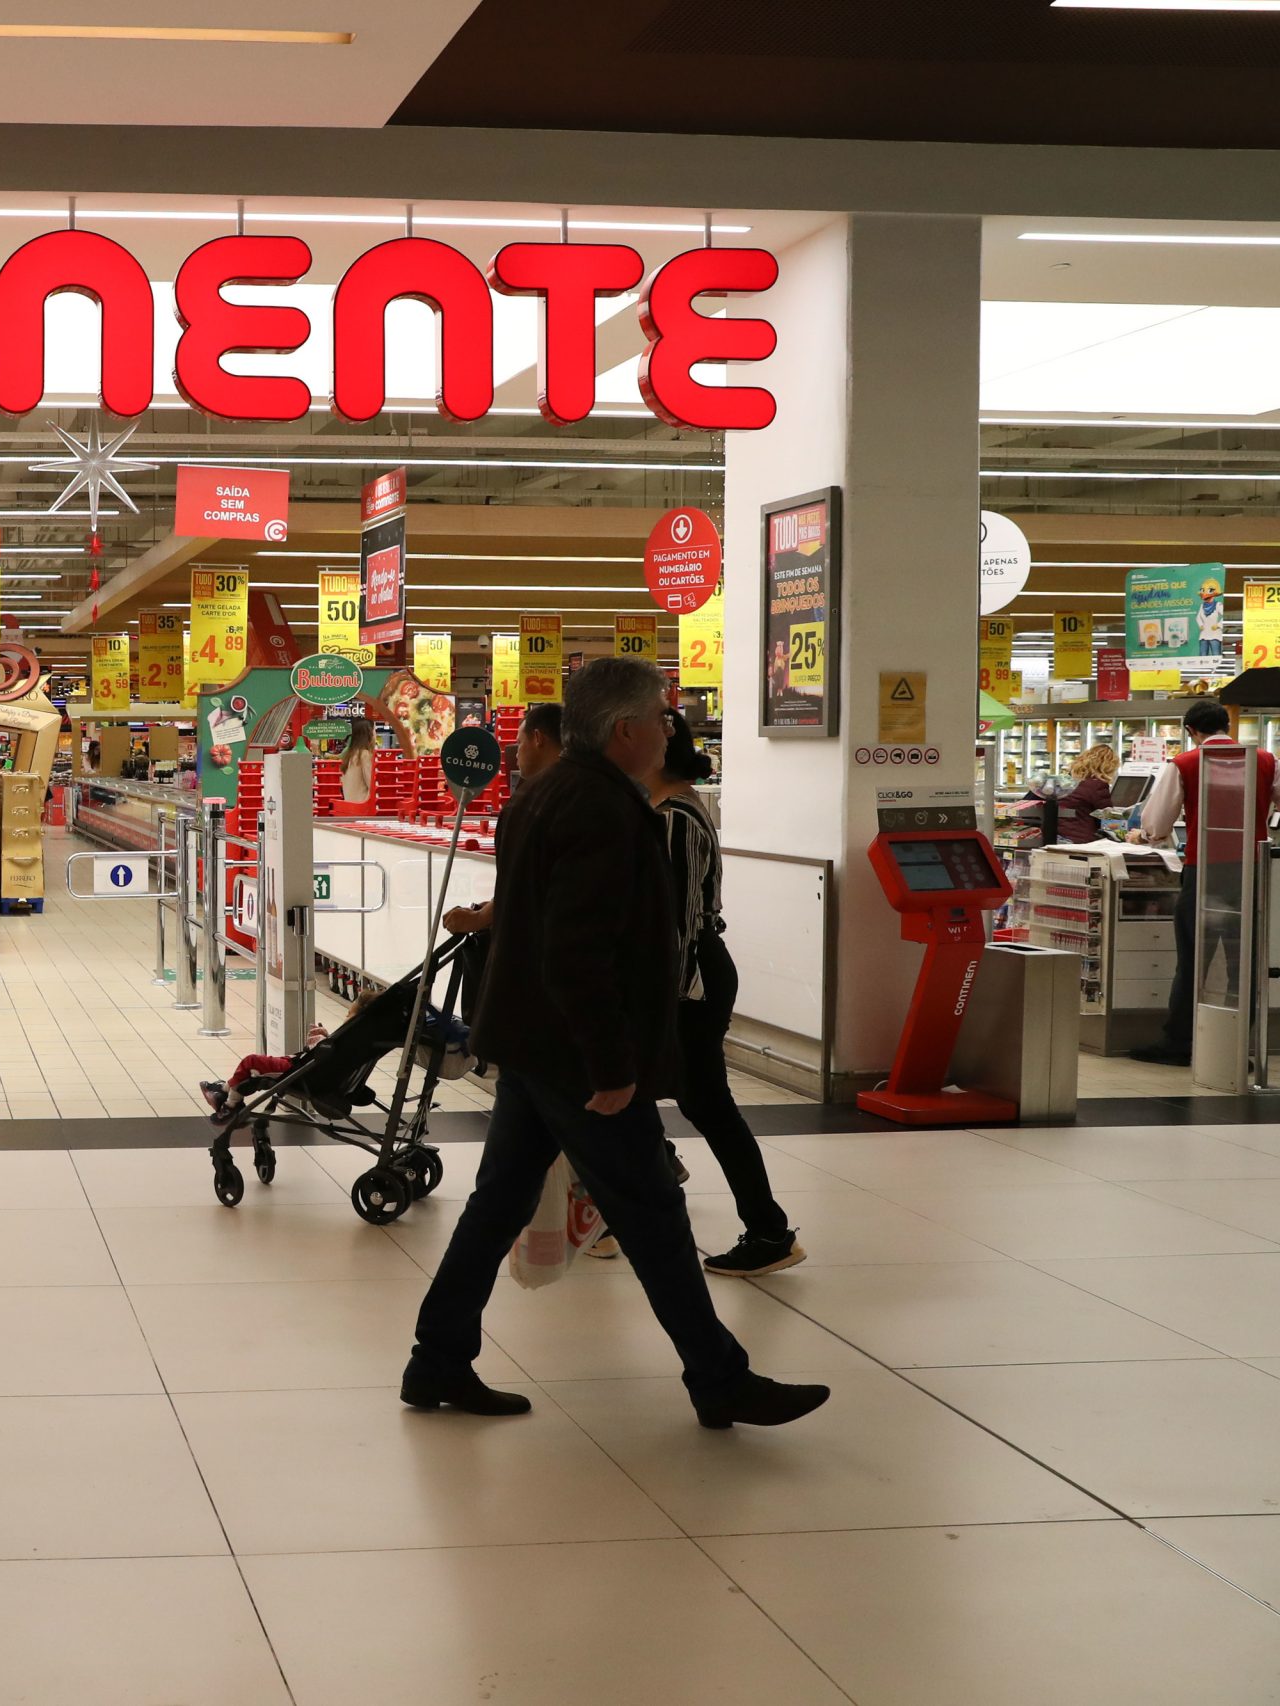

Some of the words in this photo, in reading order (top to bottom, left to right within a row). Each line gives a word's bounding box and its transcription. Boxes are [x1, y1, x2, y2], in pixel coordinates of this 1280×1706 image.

[216, 485, 250, 497] SAÍDA
[220, 499, 245, 509] SEM
[204, 511, 260, 523] COMPRAS
[774, 514, 798, 551] TUDO
[653, 551, 698, 563] PAGAMENTO
[698, 550, 710, 559] EM
[983, 557, 1018, 566] APENAS
[659, 561, 702, 574] NUMERÁRIO
[774, 570, 785, 580] ESTE
[786, 569, 794, 578] FIM
[795, 568, 801, 576] DE
[802, 565, 822, 575] SEMANA
[981, 567, 1004, 576] TÕES
[195, 573, 212, 585] TUDO
[215, 575, 245, 592] 30%
[324, 575, 347, 592] TUDO
[658, 577, 670, 586] OU
[671, 574, 705, 585] CARTÕES
[776, 578, 806, 597] TODOS
[806, 577, 819, 592] OS
[1131, 581, 1169, 592] PRESENTES
[1170, 581, 1187, 589] QUE
[770, 592, 825, 614] BRINQUEDOS
[327, 600, 359, 622] 50
[523, 617, 541, 631] TUDO
[527, 636, 554, 653] 10%
[621, 636, 651, 653] 30%
[791, 631, 824, 670] 25%
[295, 668, 361, 690] Buitoni
[446, 756, 494, 771] COLOMBO
[877, 790, 913, 799] CLICK&GO
